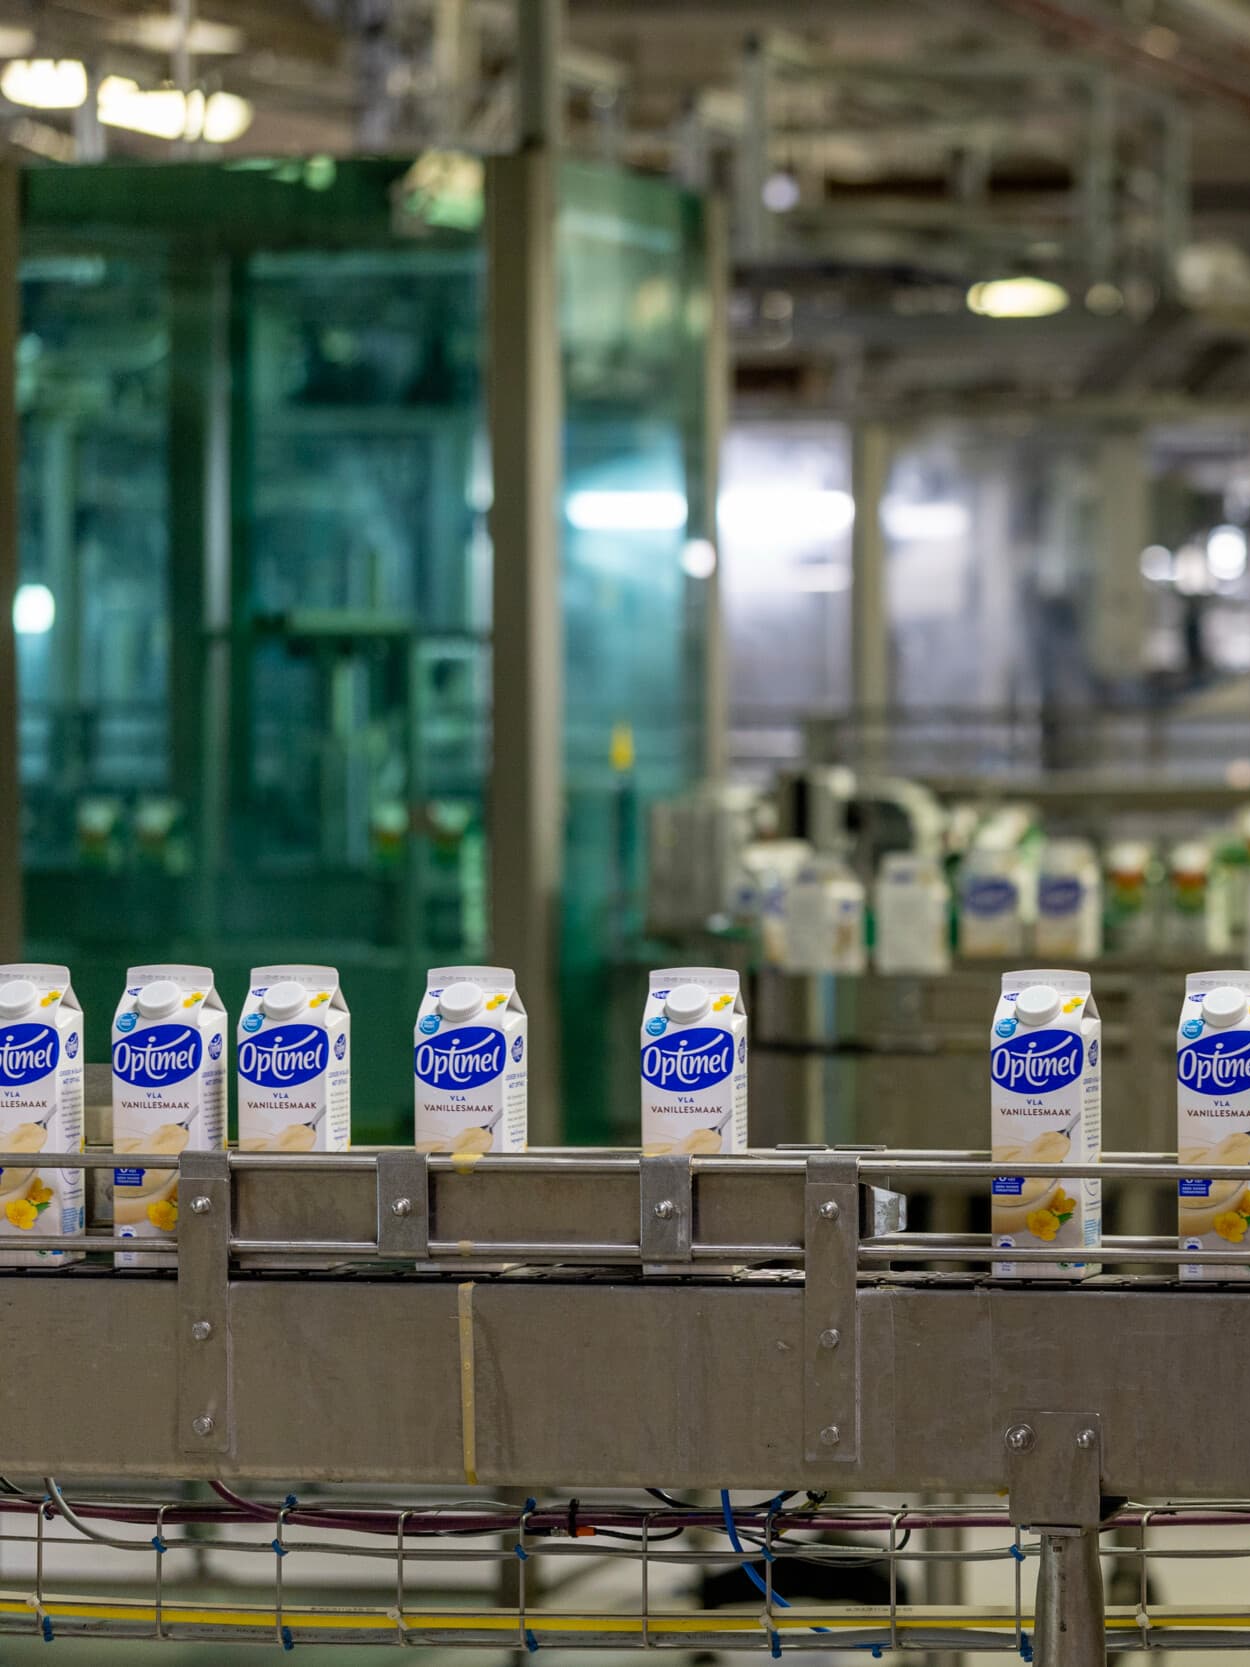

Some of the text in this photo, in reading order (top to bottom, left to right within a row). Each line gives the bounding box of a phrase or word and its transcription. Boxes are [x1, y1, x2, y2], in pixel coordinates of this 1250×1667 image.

[0, 1028, 54, 1079] timel
[113, 1029, 196, 1082] Optimel
[239, 1029, 323, 1082] Optimel
[416, 1032, 501, 1085] Optimel
[642, 1033, 729, 1086] Optimel
[992, 1035, 1078, 1089] Optimel
[3, 1090, 21, 1098] VLA
[145, 1091, 163, 1099] VLA
[272, 1092, 290, 1100] VLA
[0, 1100, 48, 1109] LLESMAAK
[122, 1100, 191, 1110] VANILLESMAAK
[677, 1096, 695, 1104] VLA
[1026, 1098, 1044, 1106] VLA
[247, 1101, 318, 1111] VANILLESMAAK
[424, 1103, 495, 1114] VANILLESMAAK
[651, 1105, 723, 1115] VANILLESMAAK
[1000, 1107, 1072, 1118] VANILLESMAAK
